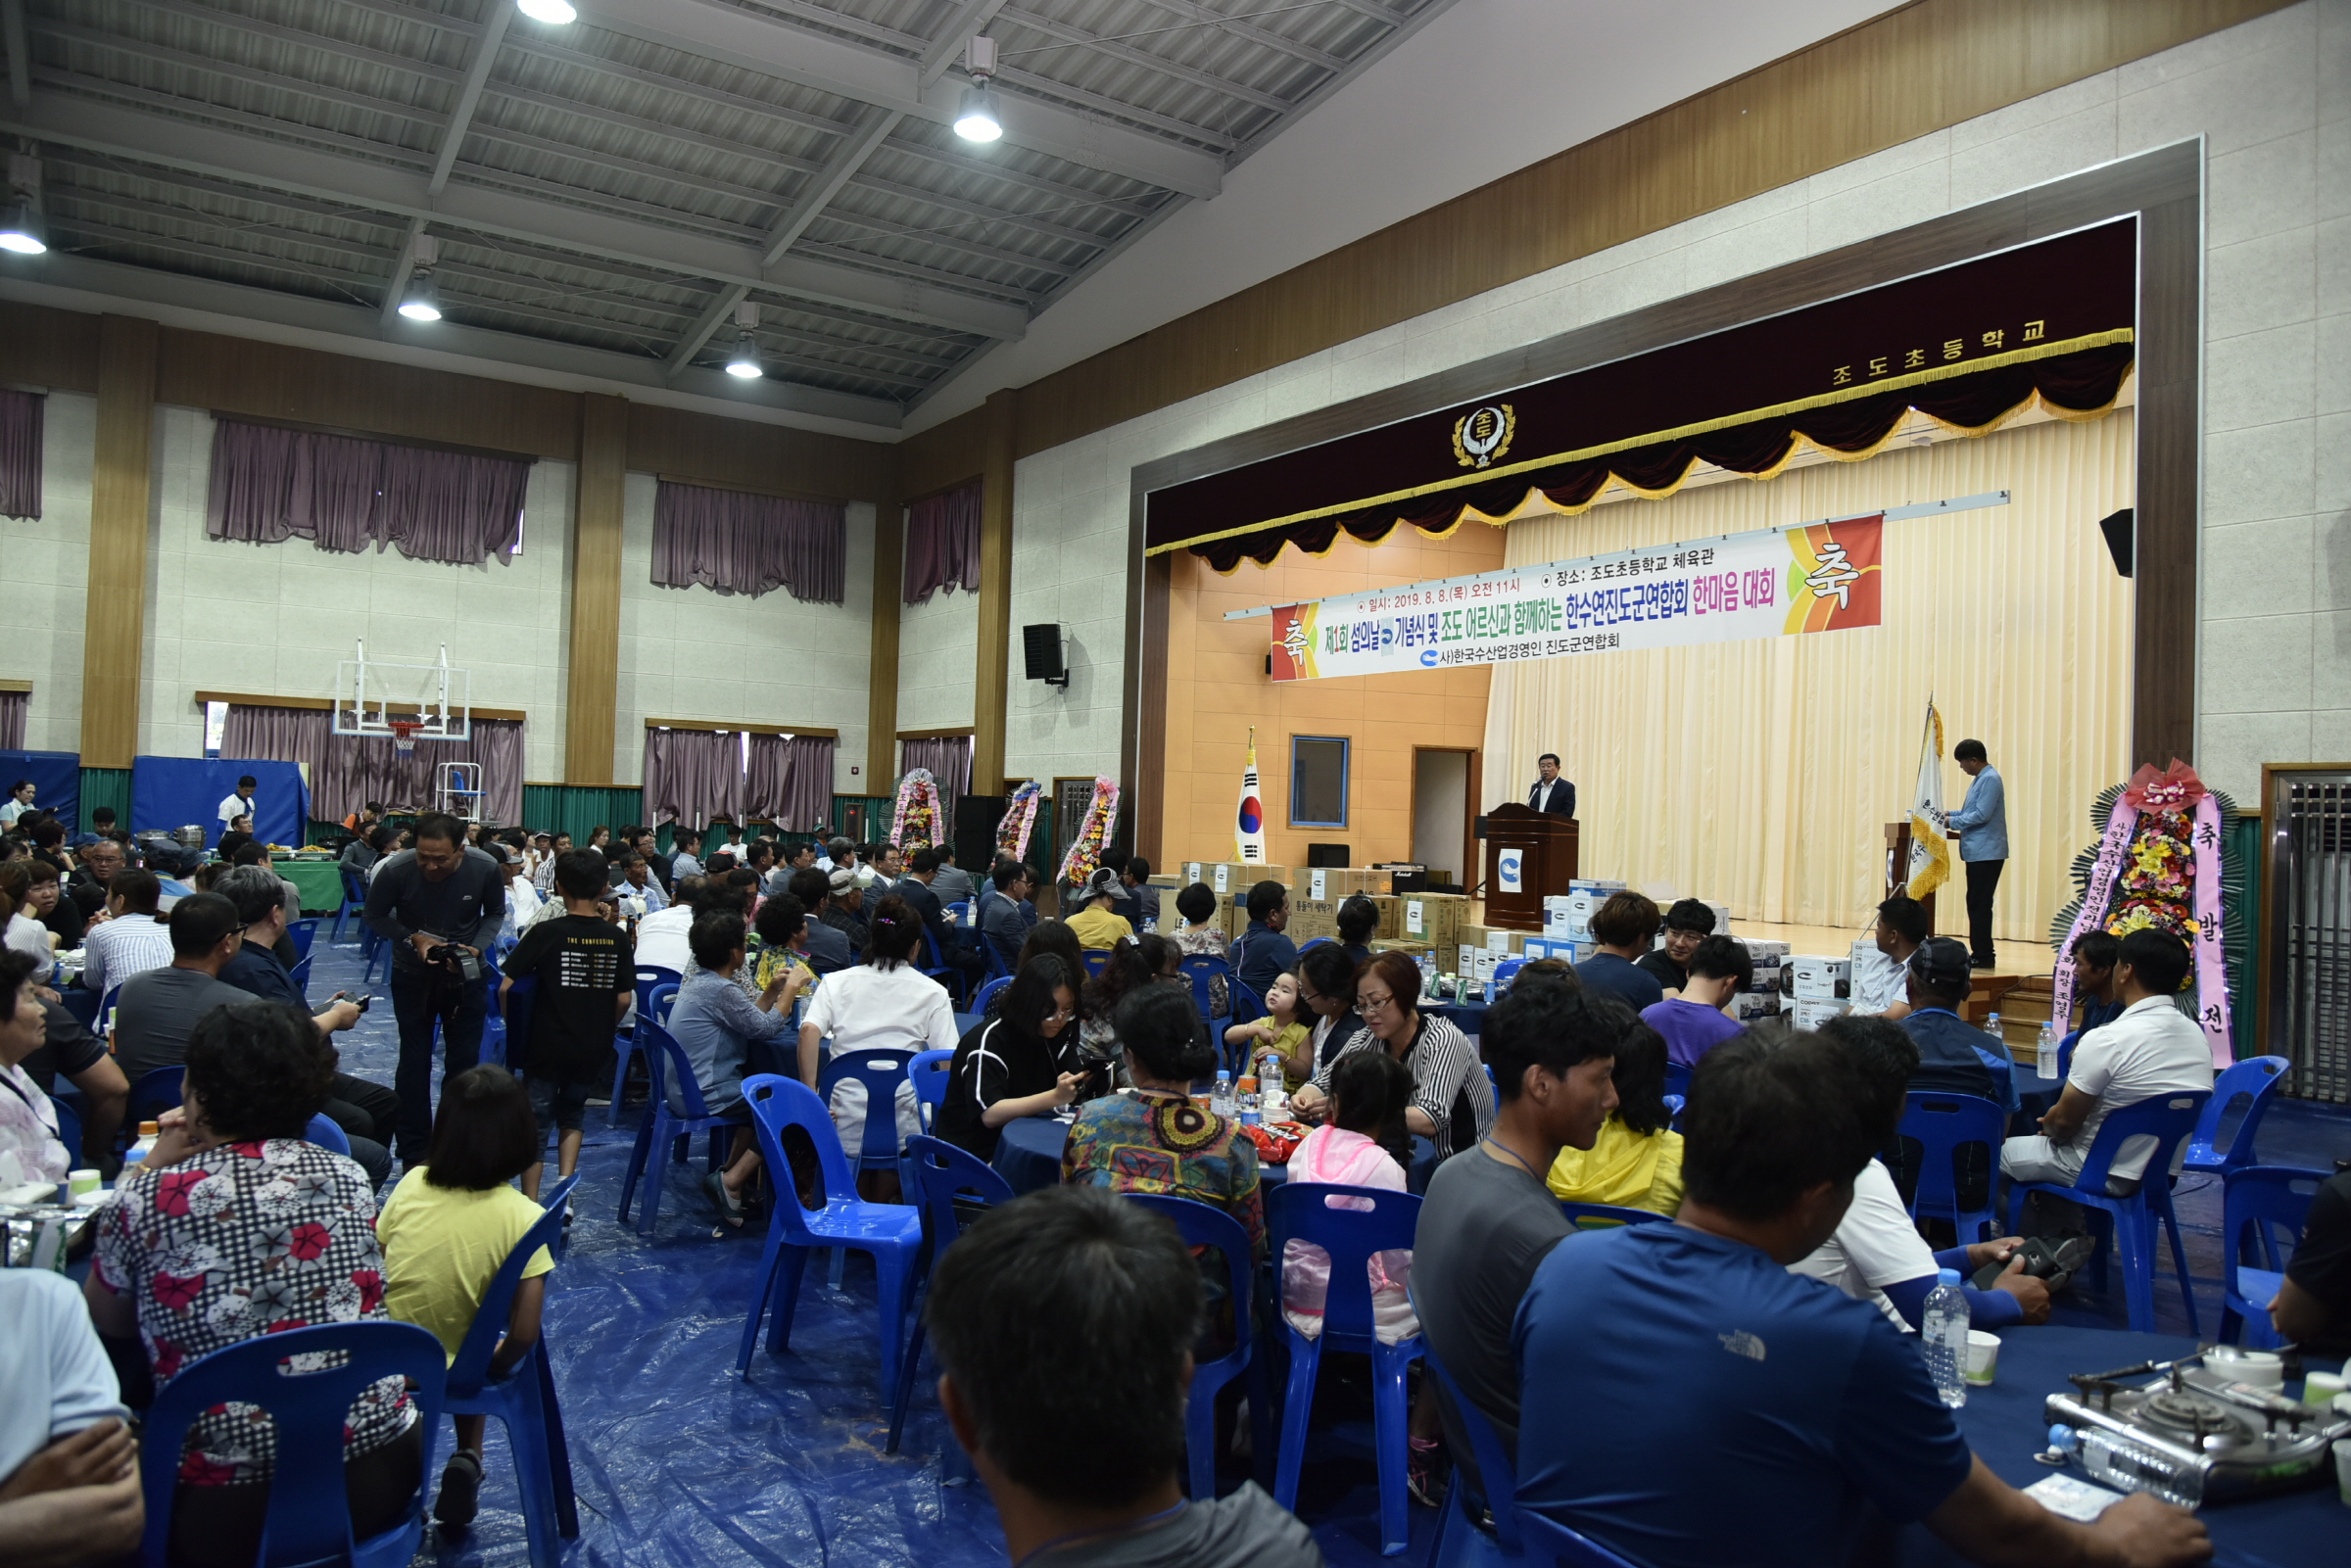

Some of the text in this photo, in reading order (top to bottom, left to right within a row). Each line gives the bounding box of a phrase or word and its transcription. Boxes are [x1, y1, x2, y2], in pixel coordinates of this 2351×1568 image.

[1833, 319, 2044, 385] 조도초등학교
[1476, 411, 1491, 439] 조도
[1368, 596, 1391, 612] 일시:
[1394, 593, 1421, 608] 2019.
[1470, 581, 1492, 597] 오전
[1496, 577, 1520, 594] 11시
[1556, 569, 1585, 587] 장소:
[1590, 555, 1668, 581] 조도초등학교
[1672, 547, 1714, 569] 체육관
[1804, 543, 1860, 610] 축
[1325, 567, 1775, 655] 제1회 섬의날 기념식 및 조도 어르신과 함께하는 한수연진도군연합회 한마음 대회
[1283, 618, 1309, 667] 축
[1439, 632, 1619, 665] 사)한국수산업경영인 진도군연합회
[1295, 900, 1333, 915] 통돌이 세탁기
